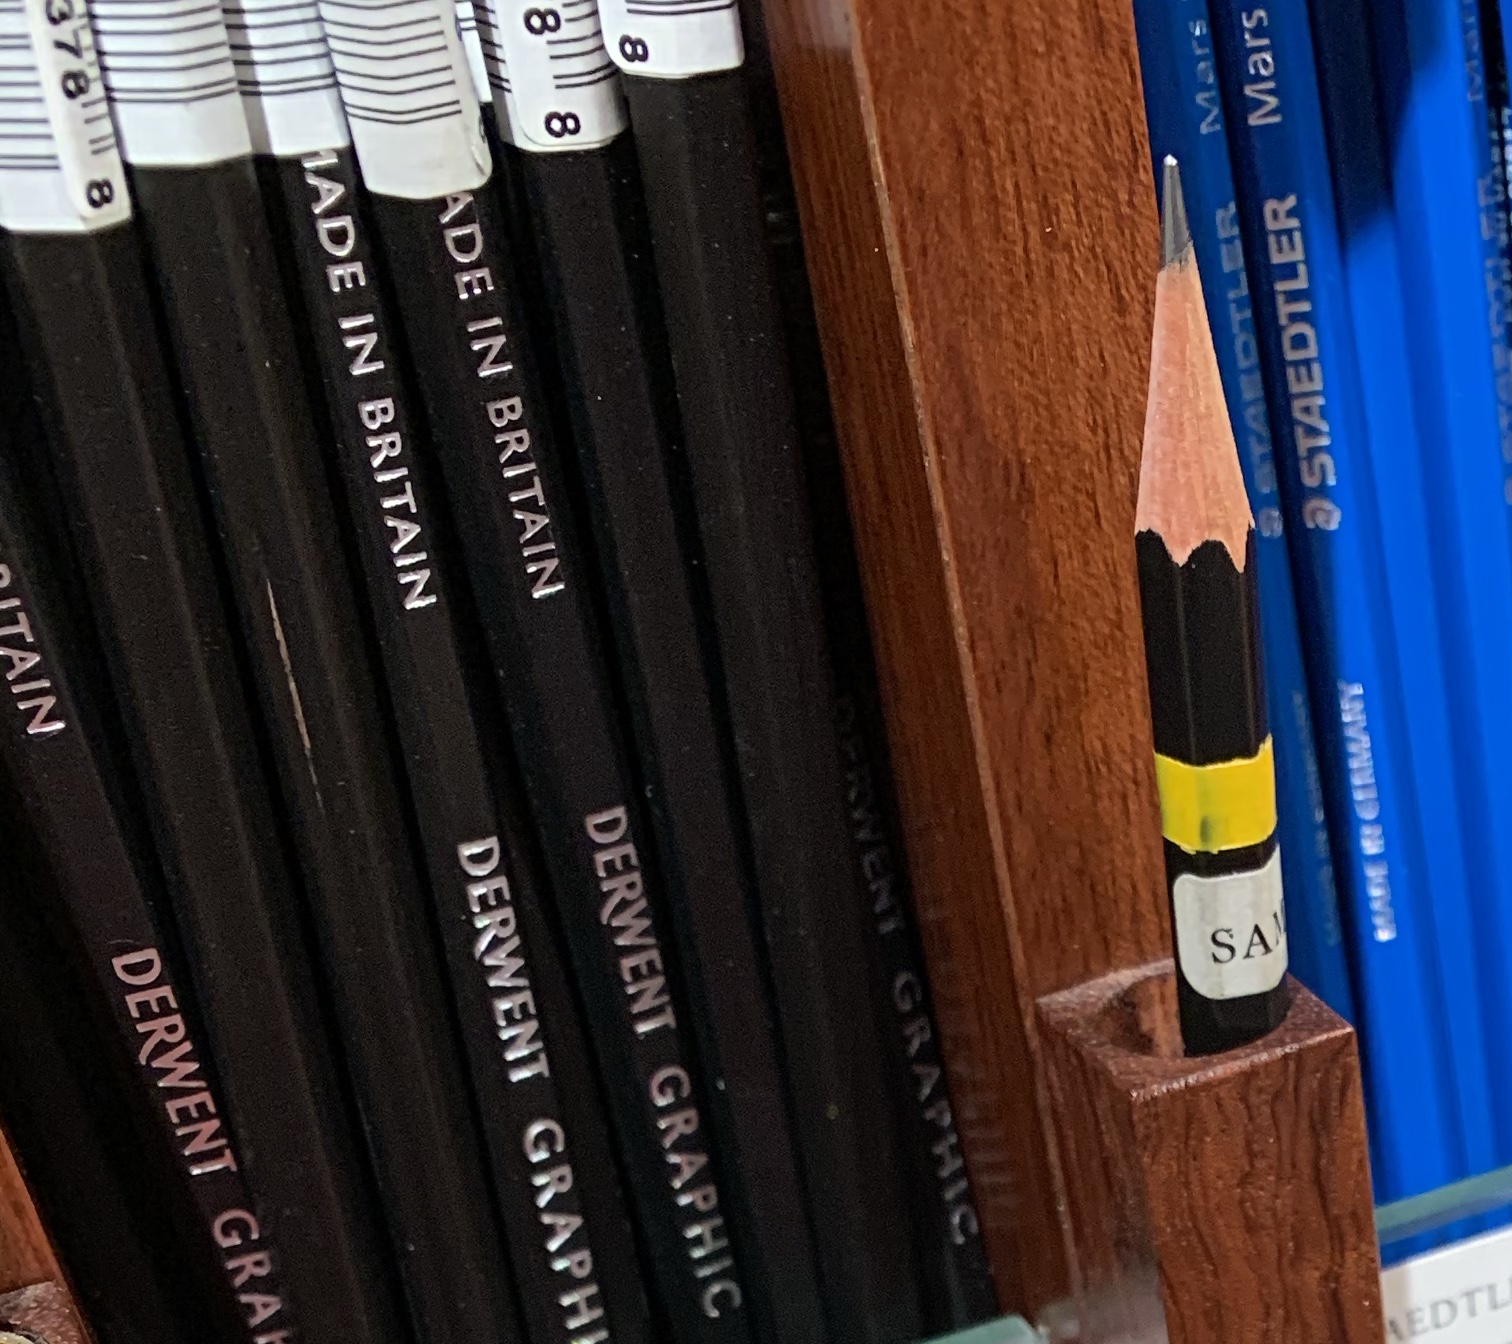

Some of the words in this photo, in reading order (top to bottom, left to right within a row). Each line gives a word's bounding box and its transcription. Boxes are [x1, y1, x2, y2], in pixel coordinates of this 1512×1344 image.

[1241, 6, 1284, 129] Mars
[337, 313, 385, 376] IN
[438, 190, 495, 300] ADE
[466, 316, 514, 378] IN
[1263, 192, 1338, 489] STAEDTLER
[357, 396, 438, 611] BRITAIN
[485, 395, 566, 600] BRITAIN
[110, 946, 238, 1177] DERWENT
[456, 835, 551, 1084] DERWENT
[584, 805, 677, 1037] DERWENT
[649, 1064, 743, 1319] GRAPHIC
[891, 970, 981, 1248] GRAPHIC
